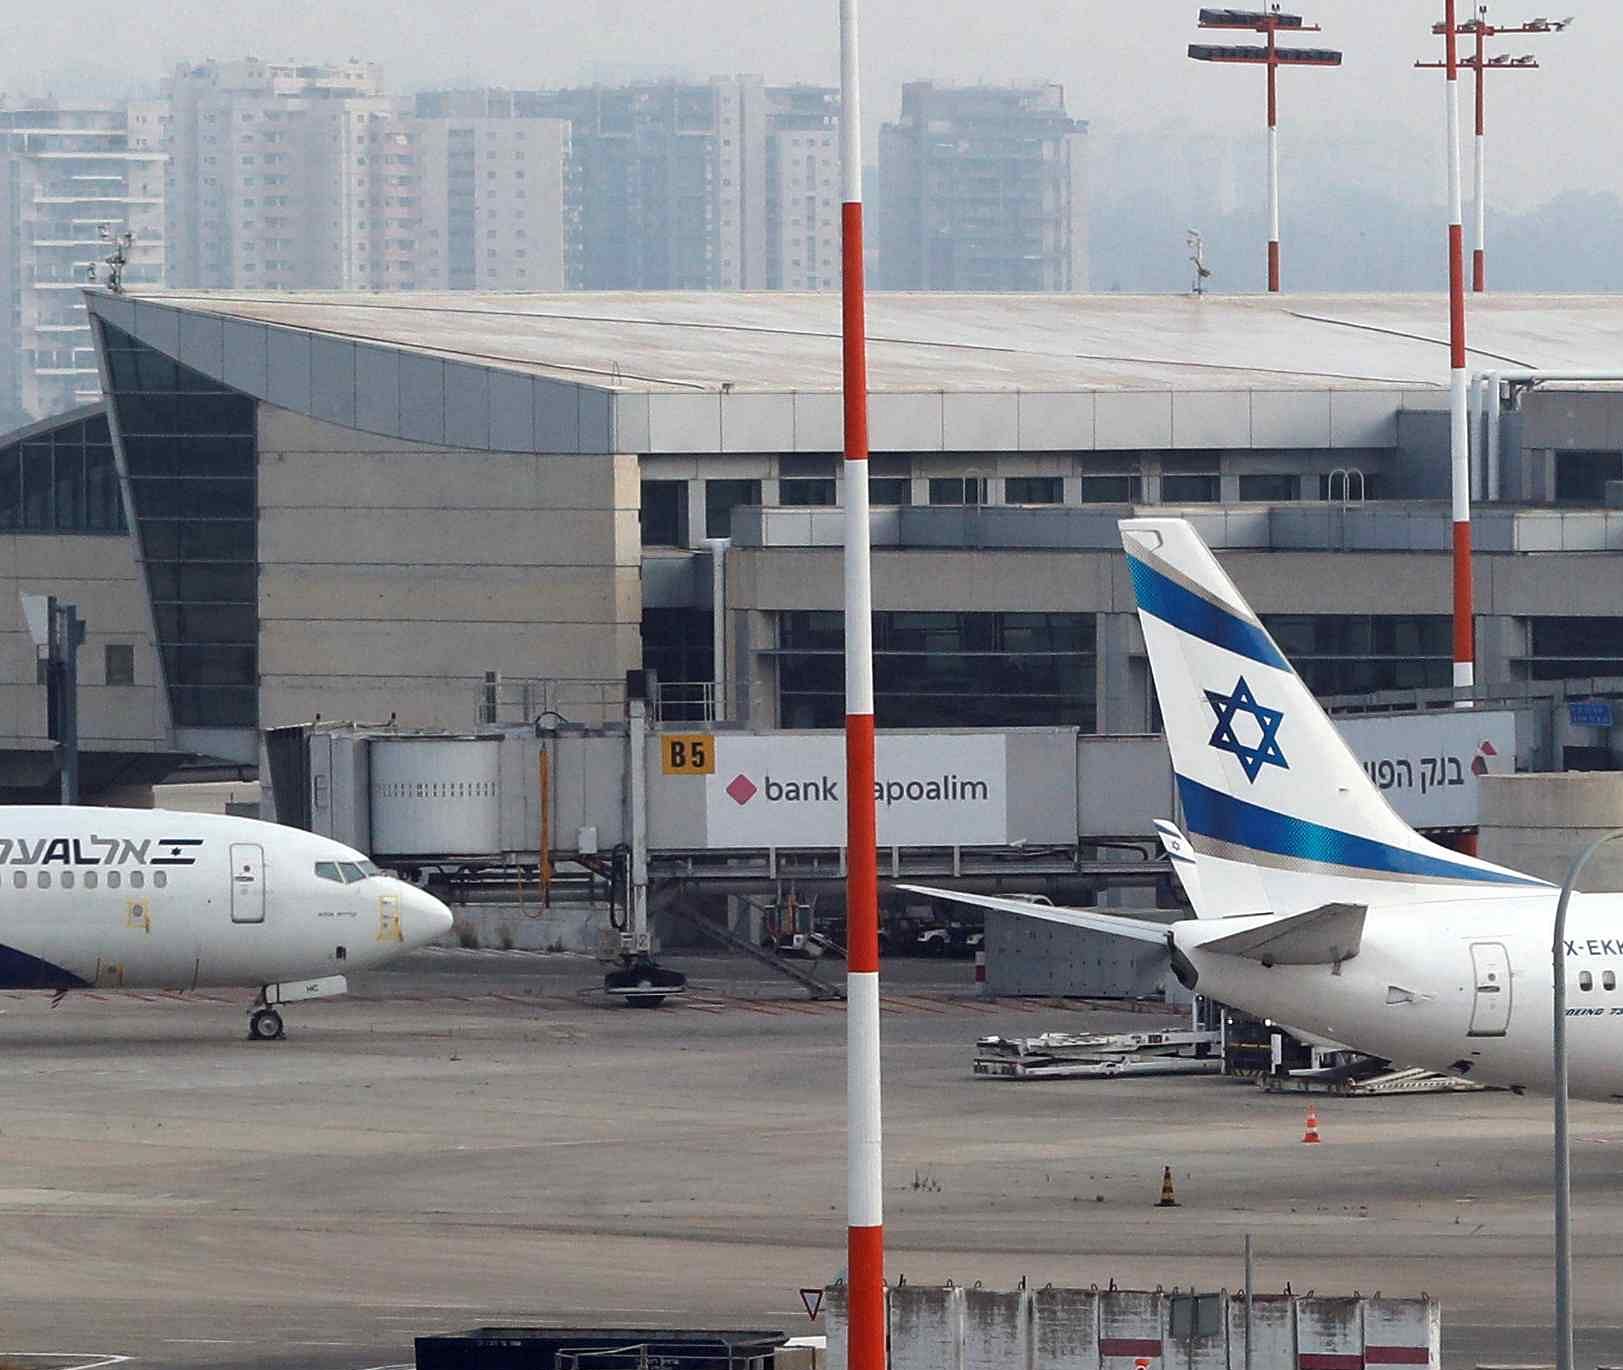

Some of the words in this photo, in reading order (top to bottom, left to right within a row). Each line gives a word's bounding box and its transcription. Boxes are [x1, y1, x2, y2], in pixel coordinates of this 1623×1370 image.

[670, 742, 705, 768] B5
[765, 776, 839, 802] bank
[875, 775, 989, 808] apoalim
[1420, 757, 1464, 795] בנק
